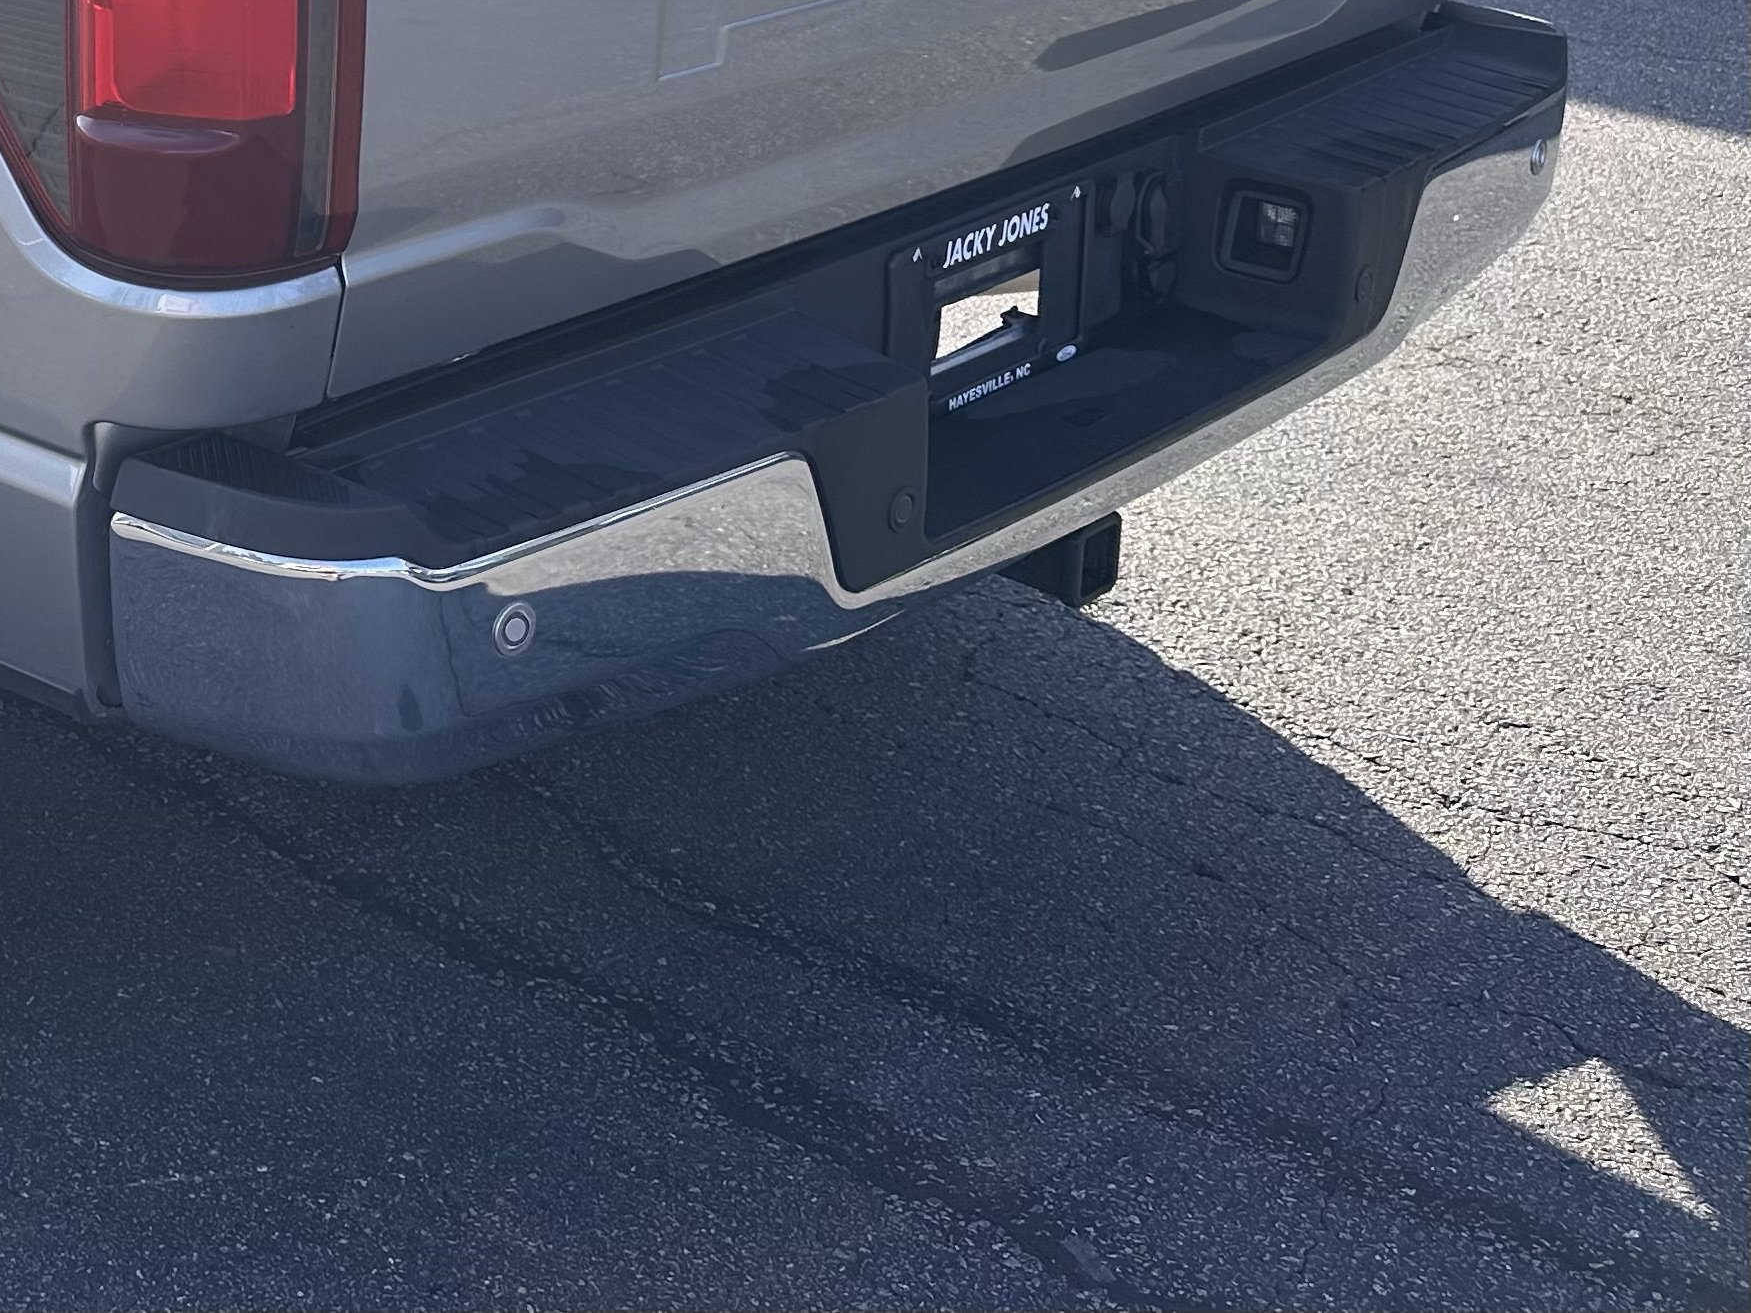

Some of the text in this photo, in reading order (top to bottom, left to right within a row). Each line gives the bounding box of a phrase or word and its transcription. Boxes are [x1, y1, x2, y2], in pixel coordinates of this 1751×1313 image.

[943, 202, 1050, 269] JACKY JONES
[1016, 362, 1032, 381] NC
